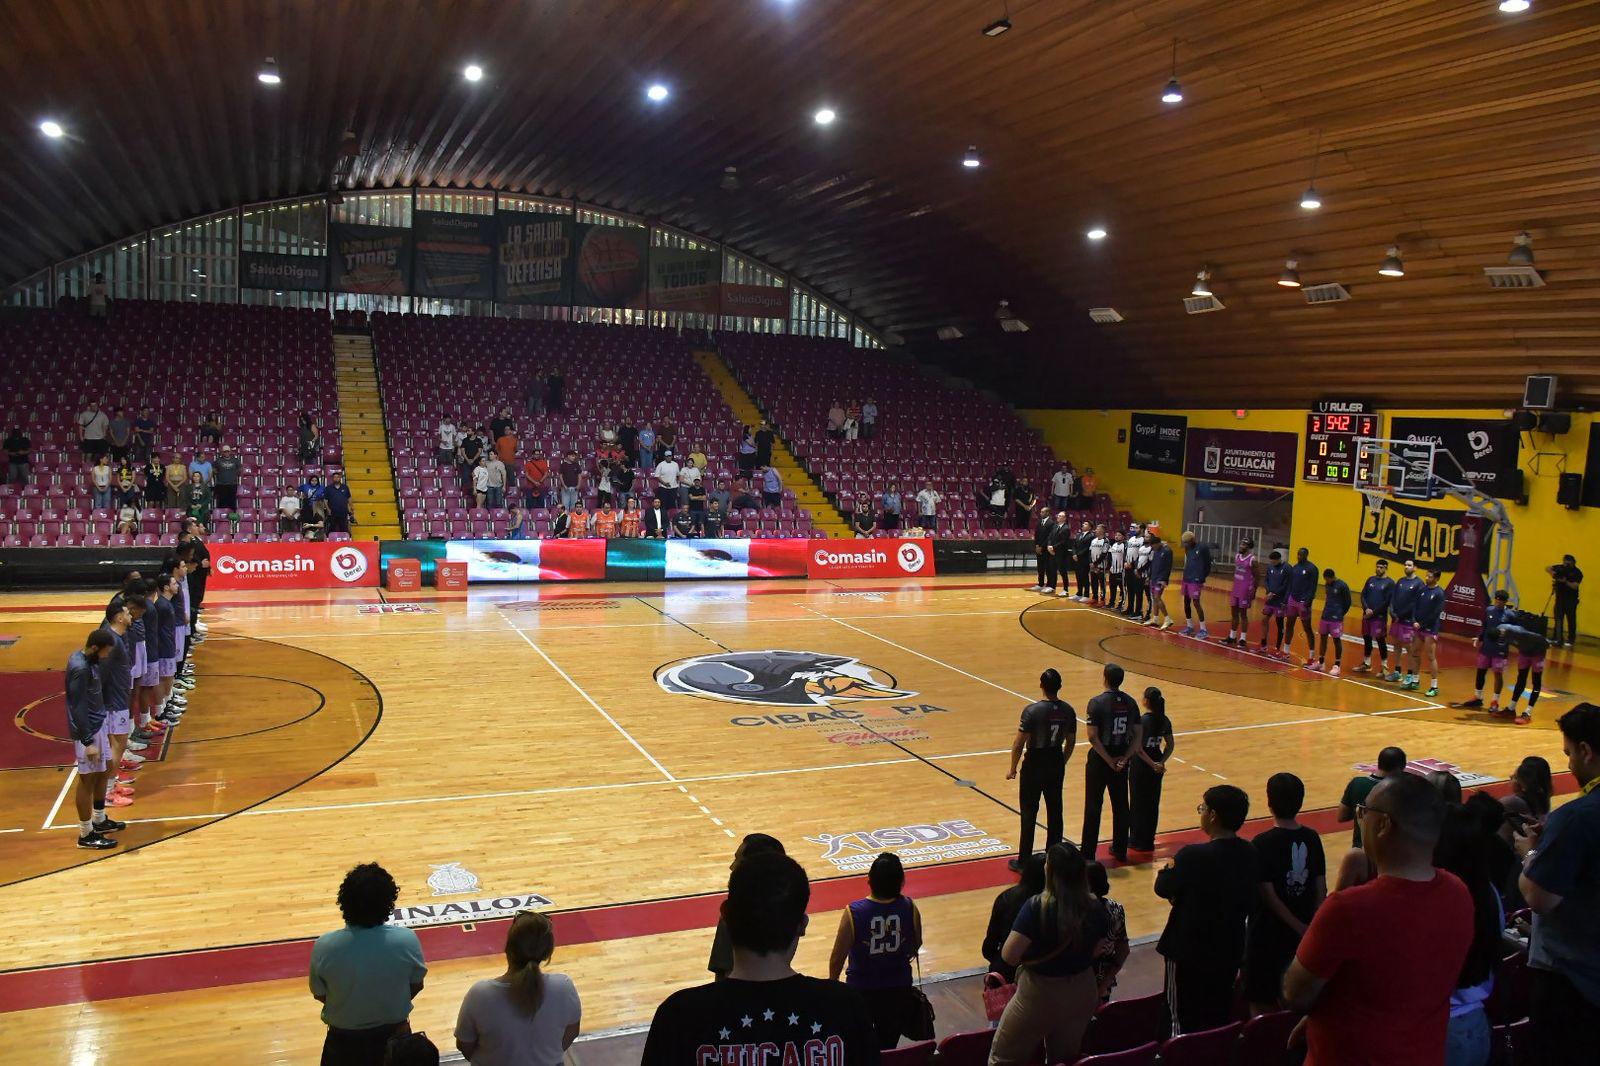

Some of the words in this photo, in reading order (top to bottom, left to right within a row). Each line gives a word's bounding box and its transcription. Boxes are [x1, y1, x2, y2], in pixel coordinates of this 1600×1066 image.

[508, 225, 521, 245] LA
[526, 221, 562, 243] SALUD
[250, 262, 319, 279] SaludDigna
[507, 257, 562, 284] DEFENSA
[728, 294, 784, 308] SaludDigna
[1329, 402, 1363, 412] RULER
[1223, 456, 1275, 471] CULIACÁN
[1224, 449, 1266, 457] AYUNTAMIENTO
[1267, 451, 1276, 459] DE
[216, 554, 315, 575] Comasin
[815, 549, 887, 566] Comasin
[343, 565, 363, 580] Berel
[1050, 724, 1060, 744] 7
[1111, 716, 1128, 736] 15
[852, 819, 988, 849] ISDE
[897, 841, 980, 857] Sinaloense
[979, 838, 1001, 846] de
[390, 893, 553, 921] INALOA
[869, 914, 901, 955] 23
[697, 1035, 845, 1066] CHICAGO
